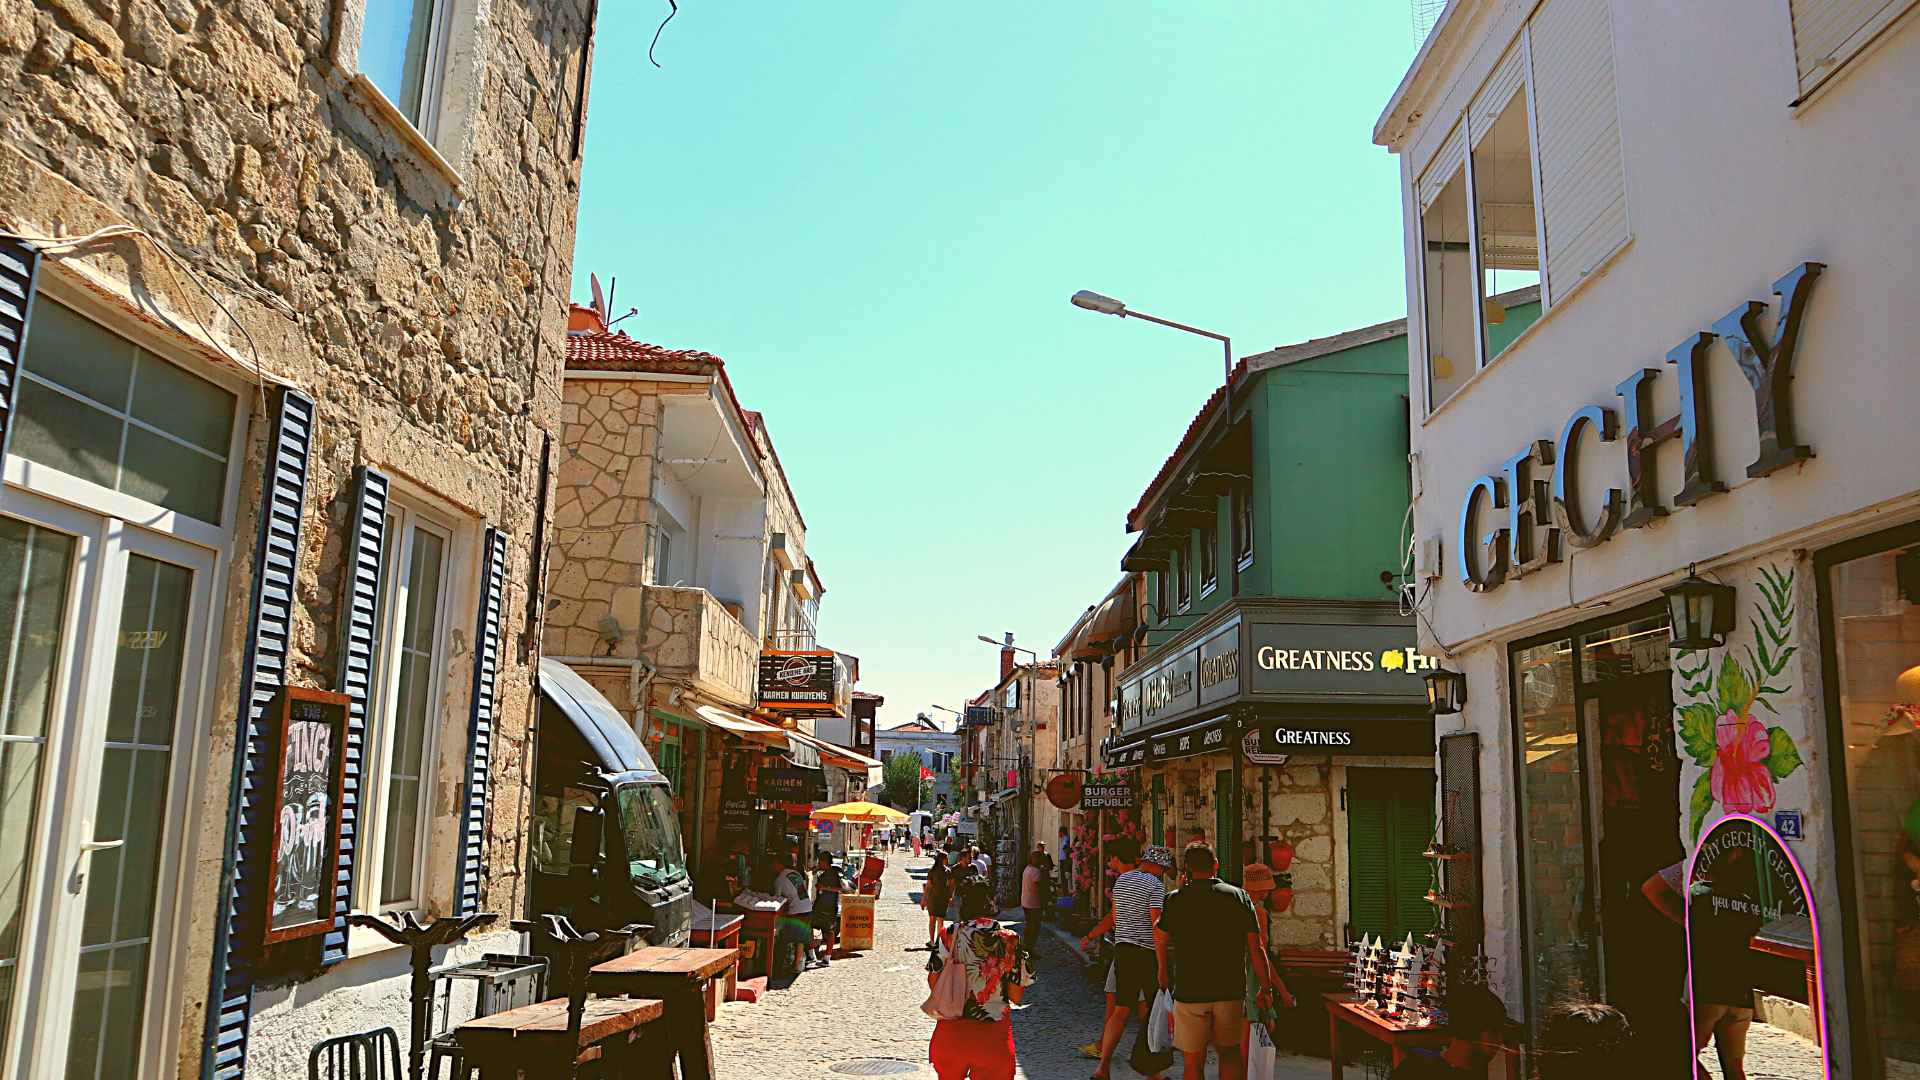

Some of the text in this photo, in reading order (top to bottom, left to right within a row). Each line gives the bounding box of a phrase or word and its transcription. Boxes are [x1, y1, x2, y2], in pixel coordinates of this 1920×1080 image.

[1458, 261, 1827, 593] GECHY
[1201, 648, 1239, 689] GREATNESS
[1256, 646, 1375, 672] GREATNESS
[763, 690, 790, 699] KARMEN
[1275, 728, 1351, 745] GREATNESS
[1084, 787, 1131, 797] BURGER
[1084, 798, 1133, 808] REPUBLIC
[1780, 818, 1796, 836] 42
[1721, 830, 1766, 855] GECHY
[1712, 895, 1729, 917] you
[1731, 899, 1748, 913] are
